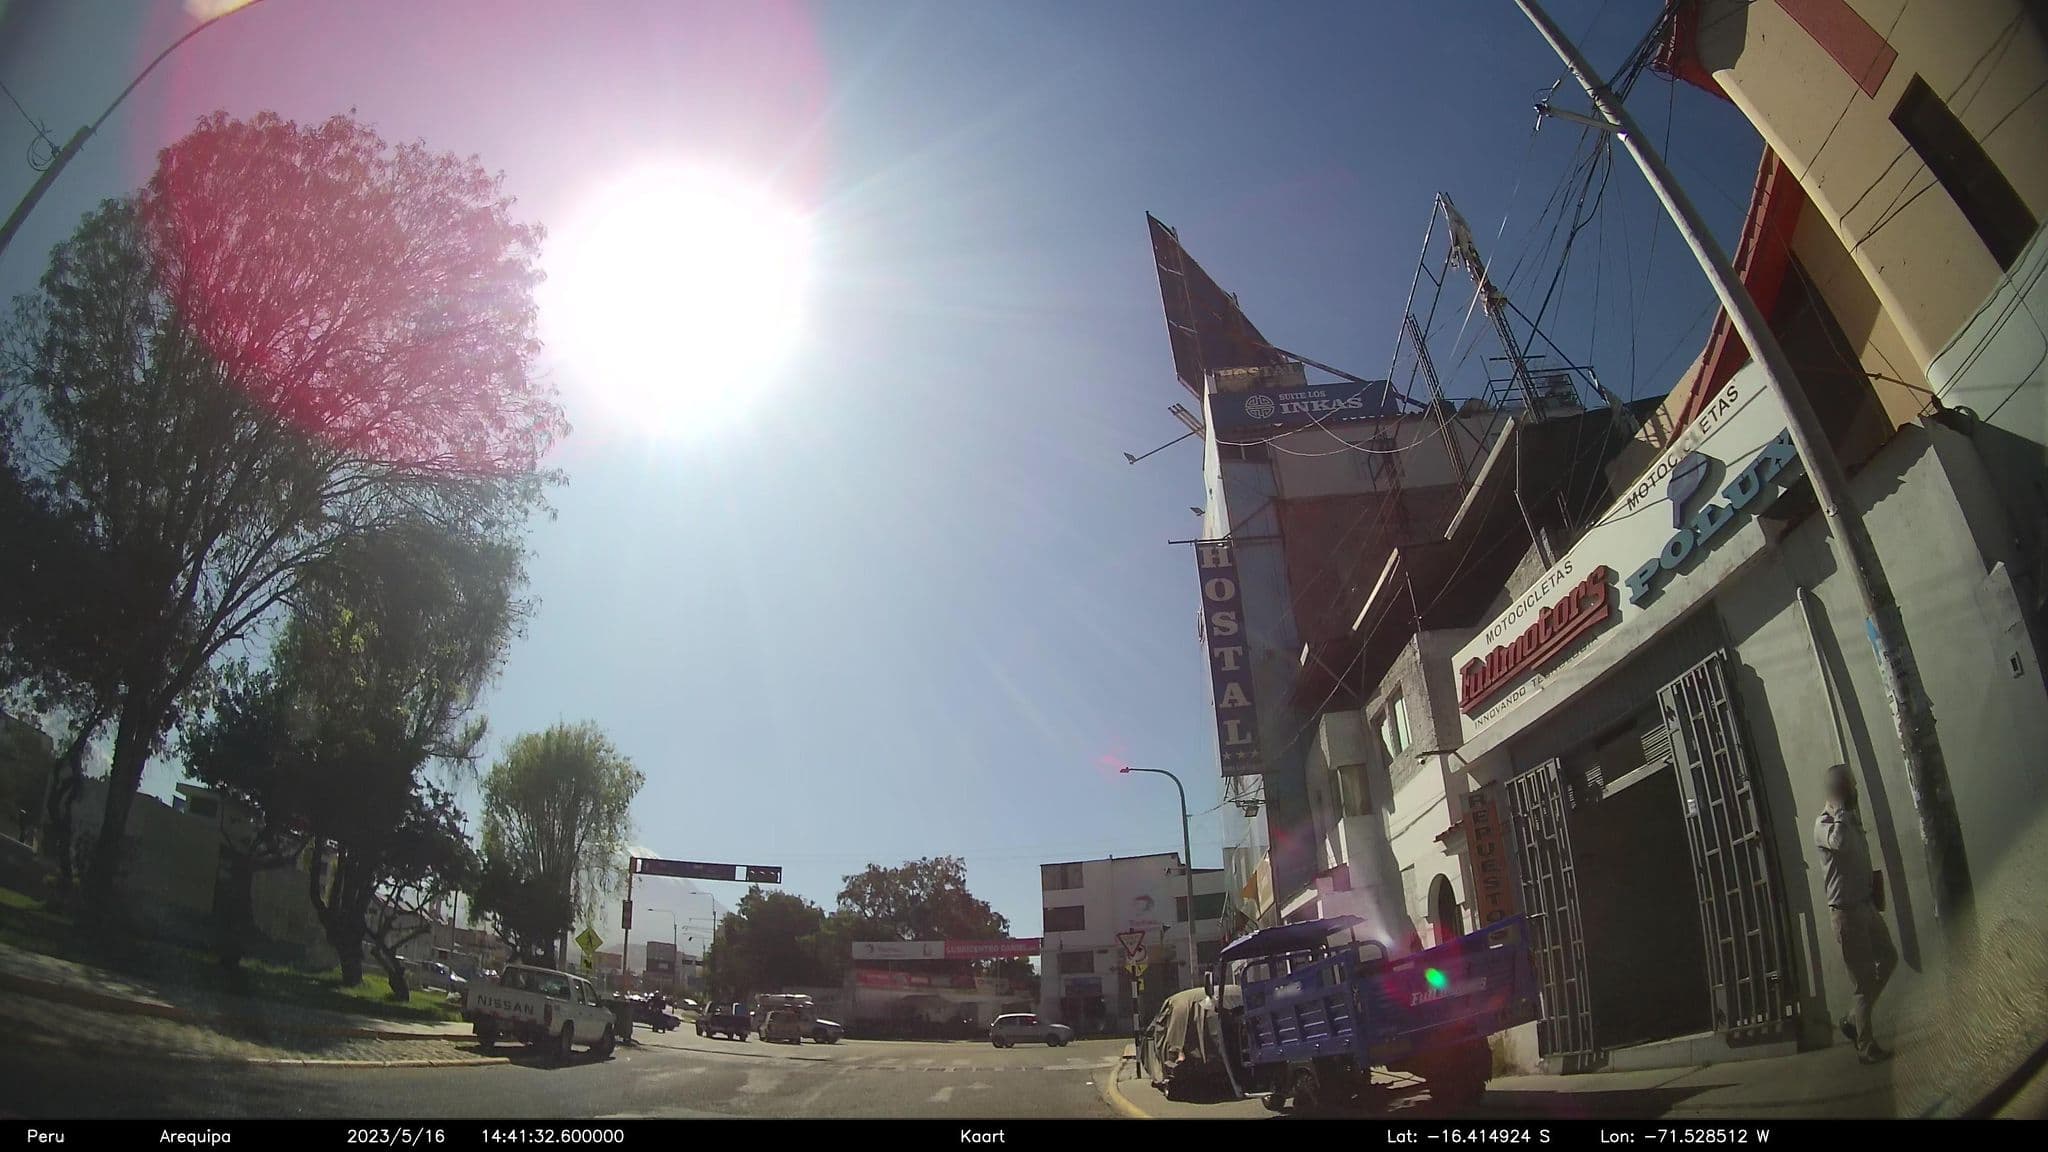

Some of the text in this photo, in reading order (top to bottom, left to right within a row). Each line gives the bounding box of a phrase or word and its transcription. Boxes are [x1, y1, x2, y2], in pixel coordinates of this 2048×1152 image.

[1279, 390, 1326, 401] SUITE LOS
[1280, 396, 1364, 415] INKAS
[1625, 426, 1798, 604] POLUX
[1486, 560, 1574, 646] MOTOCICLETAS
[1201, 546, 1252, 746] HOSTAL
[1474, 685, 1527, 730] INNOVANDO
[477, 994, 535, 1016] NISSAN
